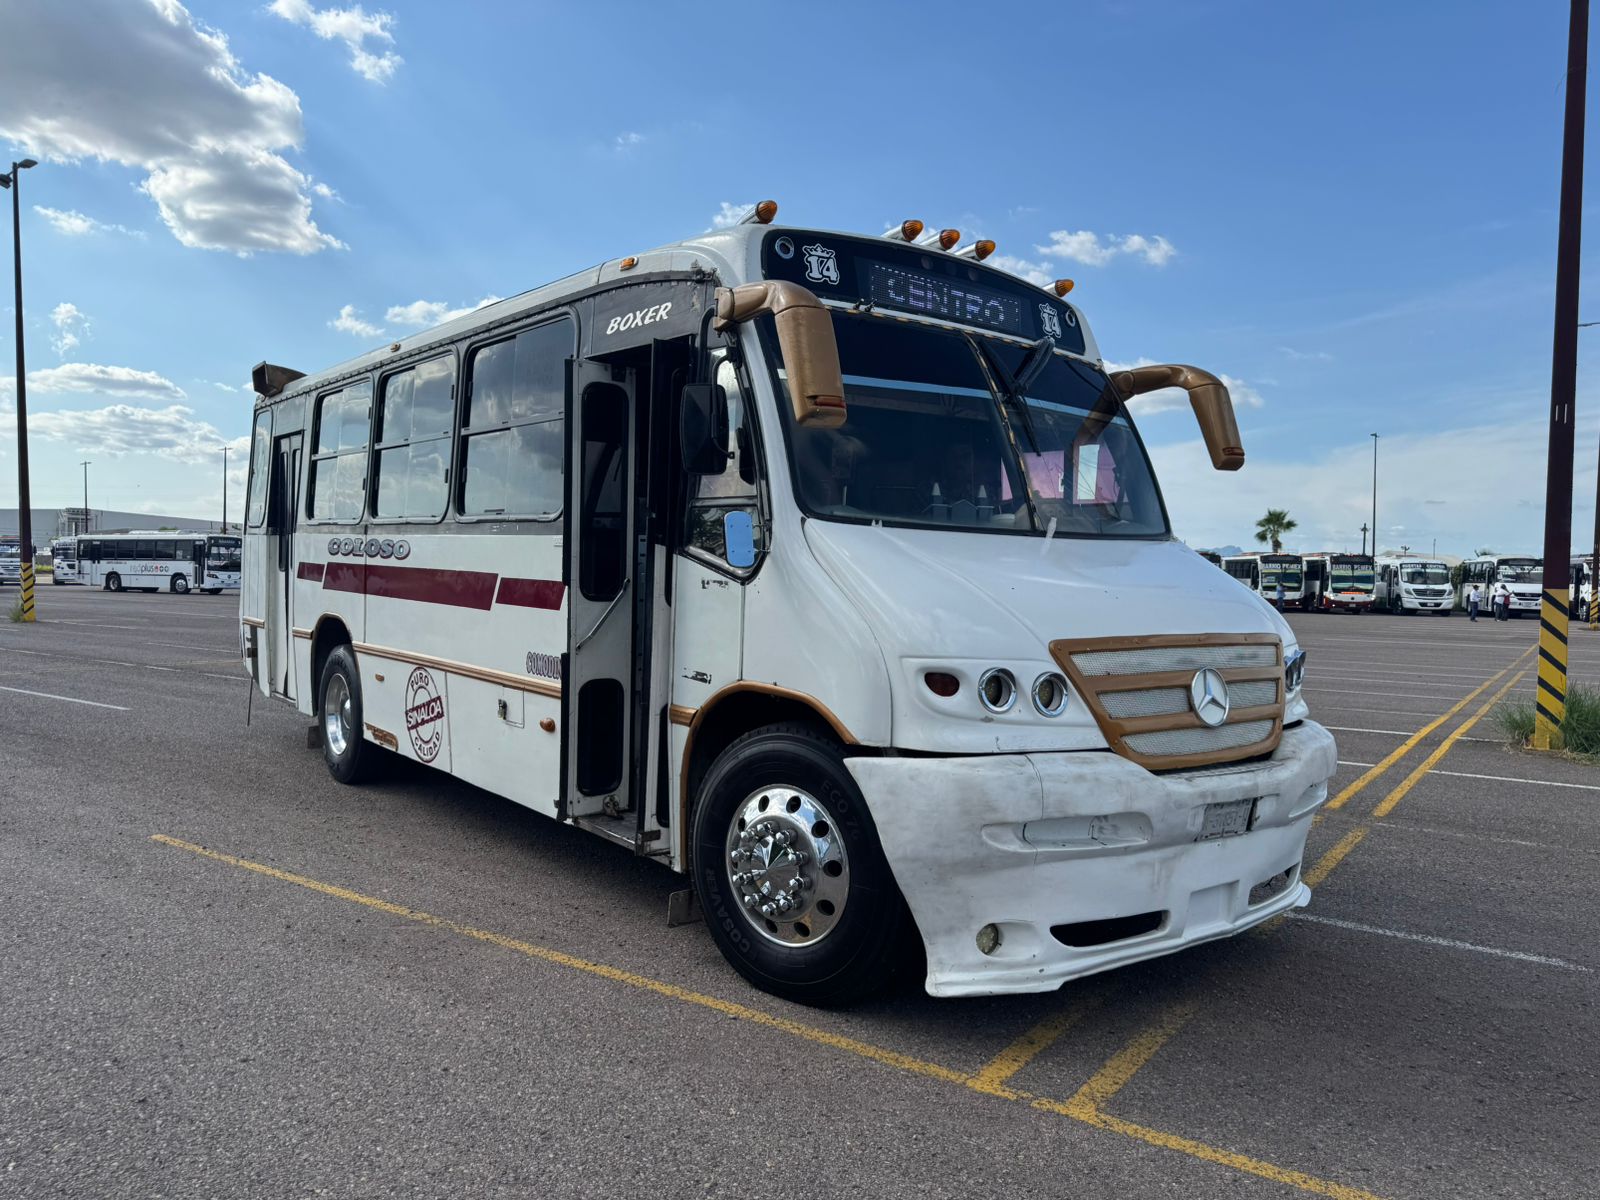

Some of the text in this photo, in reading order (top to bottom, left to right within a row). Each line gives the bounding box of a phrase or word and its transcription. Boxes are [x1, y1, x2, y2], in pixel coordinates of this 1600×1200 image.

[806, 255, 840, 284] 14
[887, 277, 1006, 326] CENTRO
[606, 301, 672, 335] BOXER
[1040, 315, 1062, 338] 14
[327, 537, 412, 561] COLOSO
[410, 671, 430, 692] PURO
[407, 697, 444, 729] SINALOA
[414, 730, 441, 758] CALIDAD
